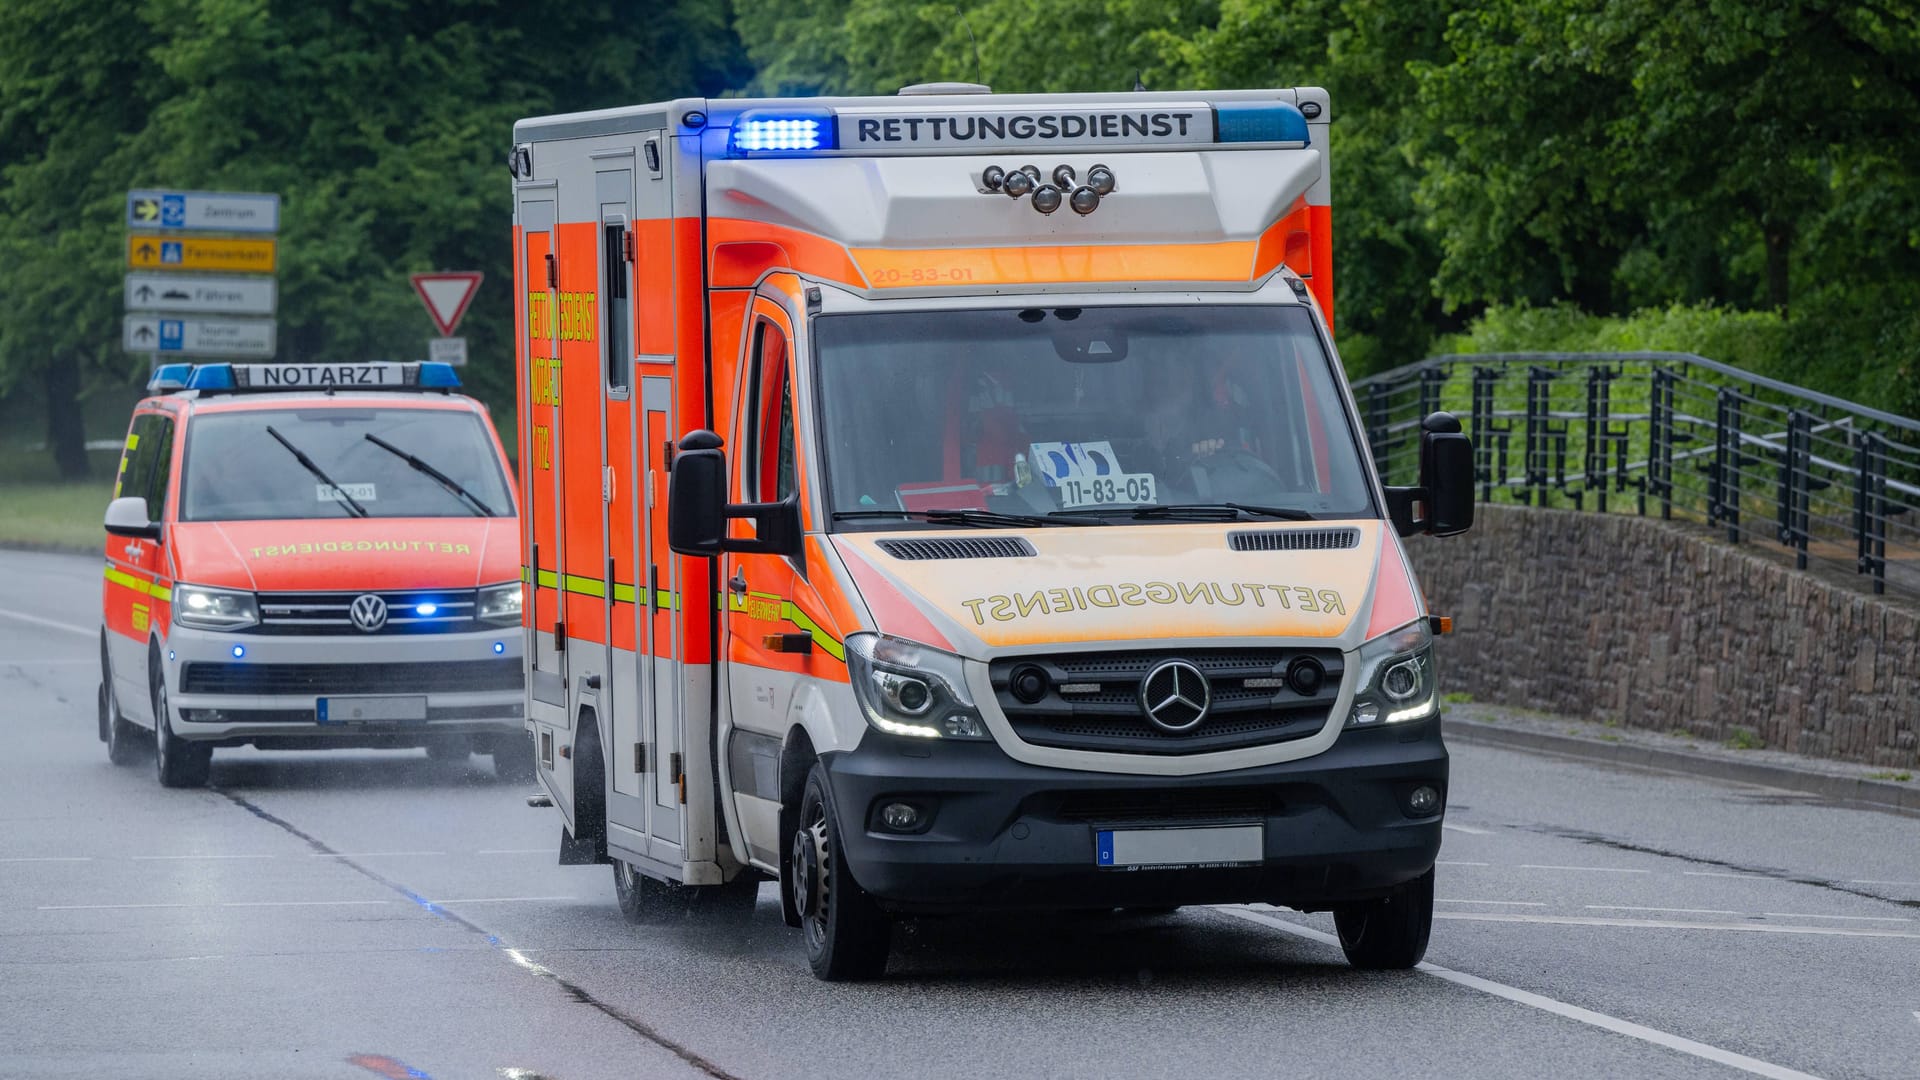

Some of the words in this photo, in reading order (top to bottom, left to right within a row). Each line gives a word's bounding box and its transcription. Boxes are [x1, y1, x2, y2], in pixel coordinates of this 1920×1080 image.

[857, 112, 1194, 142] RETTUNGSDIENST
[204, 204, 256, 219] Zentrum
[872, 267, 973, 284] 20-83-01
[528, 290, 596, 342] RETTUNGSDIENST
[264, 365, 389, 386] NOTARZT
[1066, 477, 1151, 505] 11-83-05
